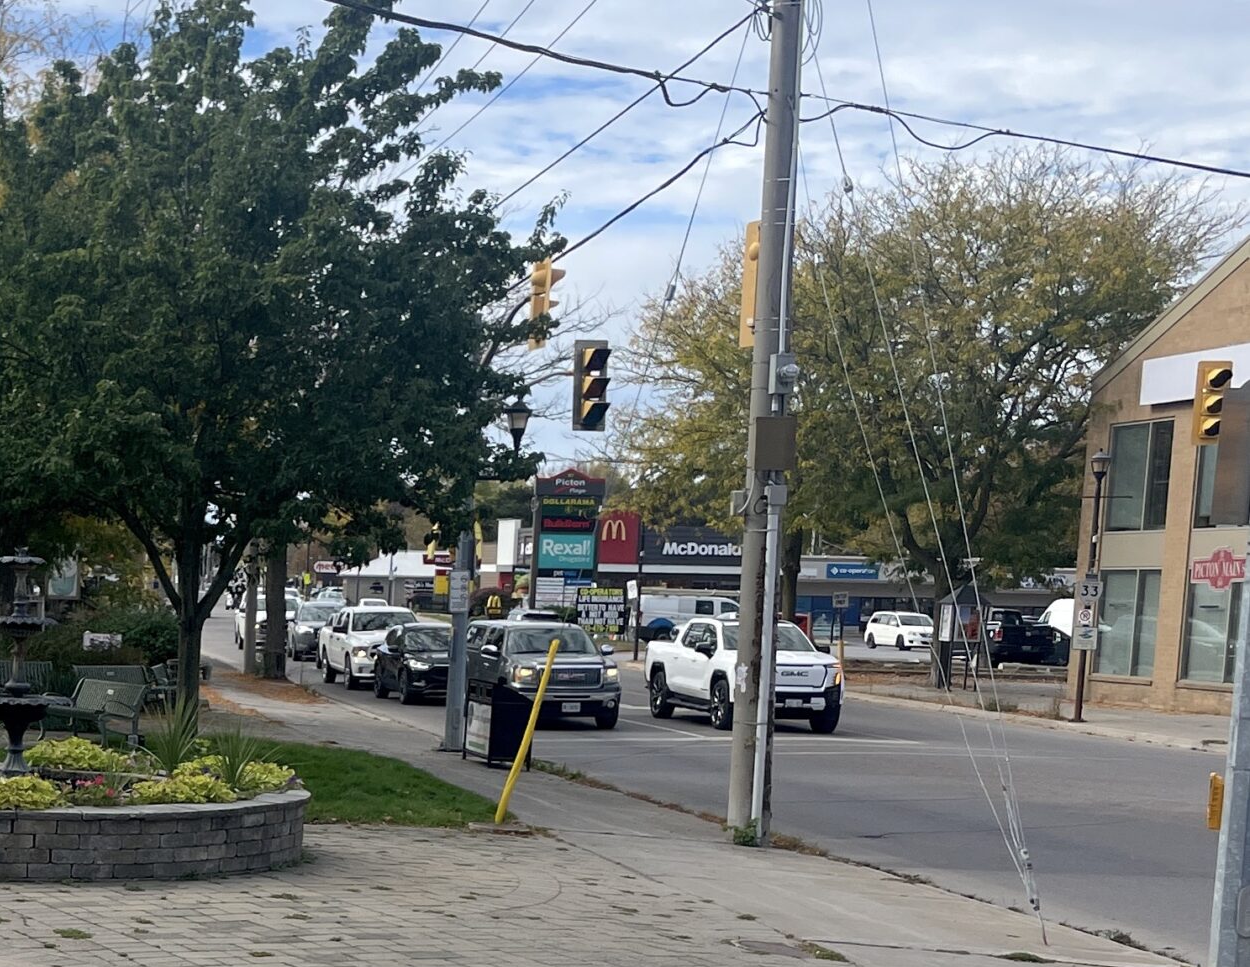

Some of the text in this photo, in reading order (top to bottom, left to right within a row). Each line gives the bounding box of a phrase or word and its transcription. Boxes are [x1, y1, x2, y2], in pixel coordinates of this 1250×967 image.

[555, 478, 586, 486] Picton
[542, 538, 591, 556] Rexall
[662, 541, 742, 556] McDonald
[1194, 561, 1219, 578] PICTON
[1081, 585, 1098, 597] 33
